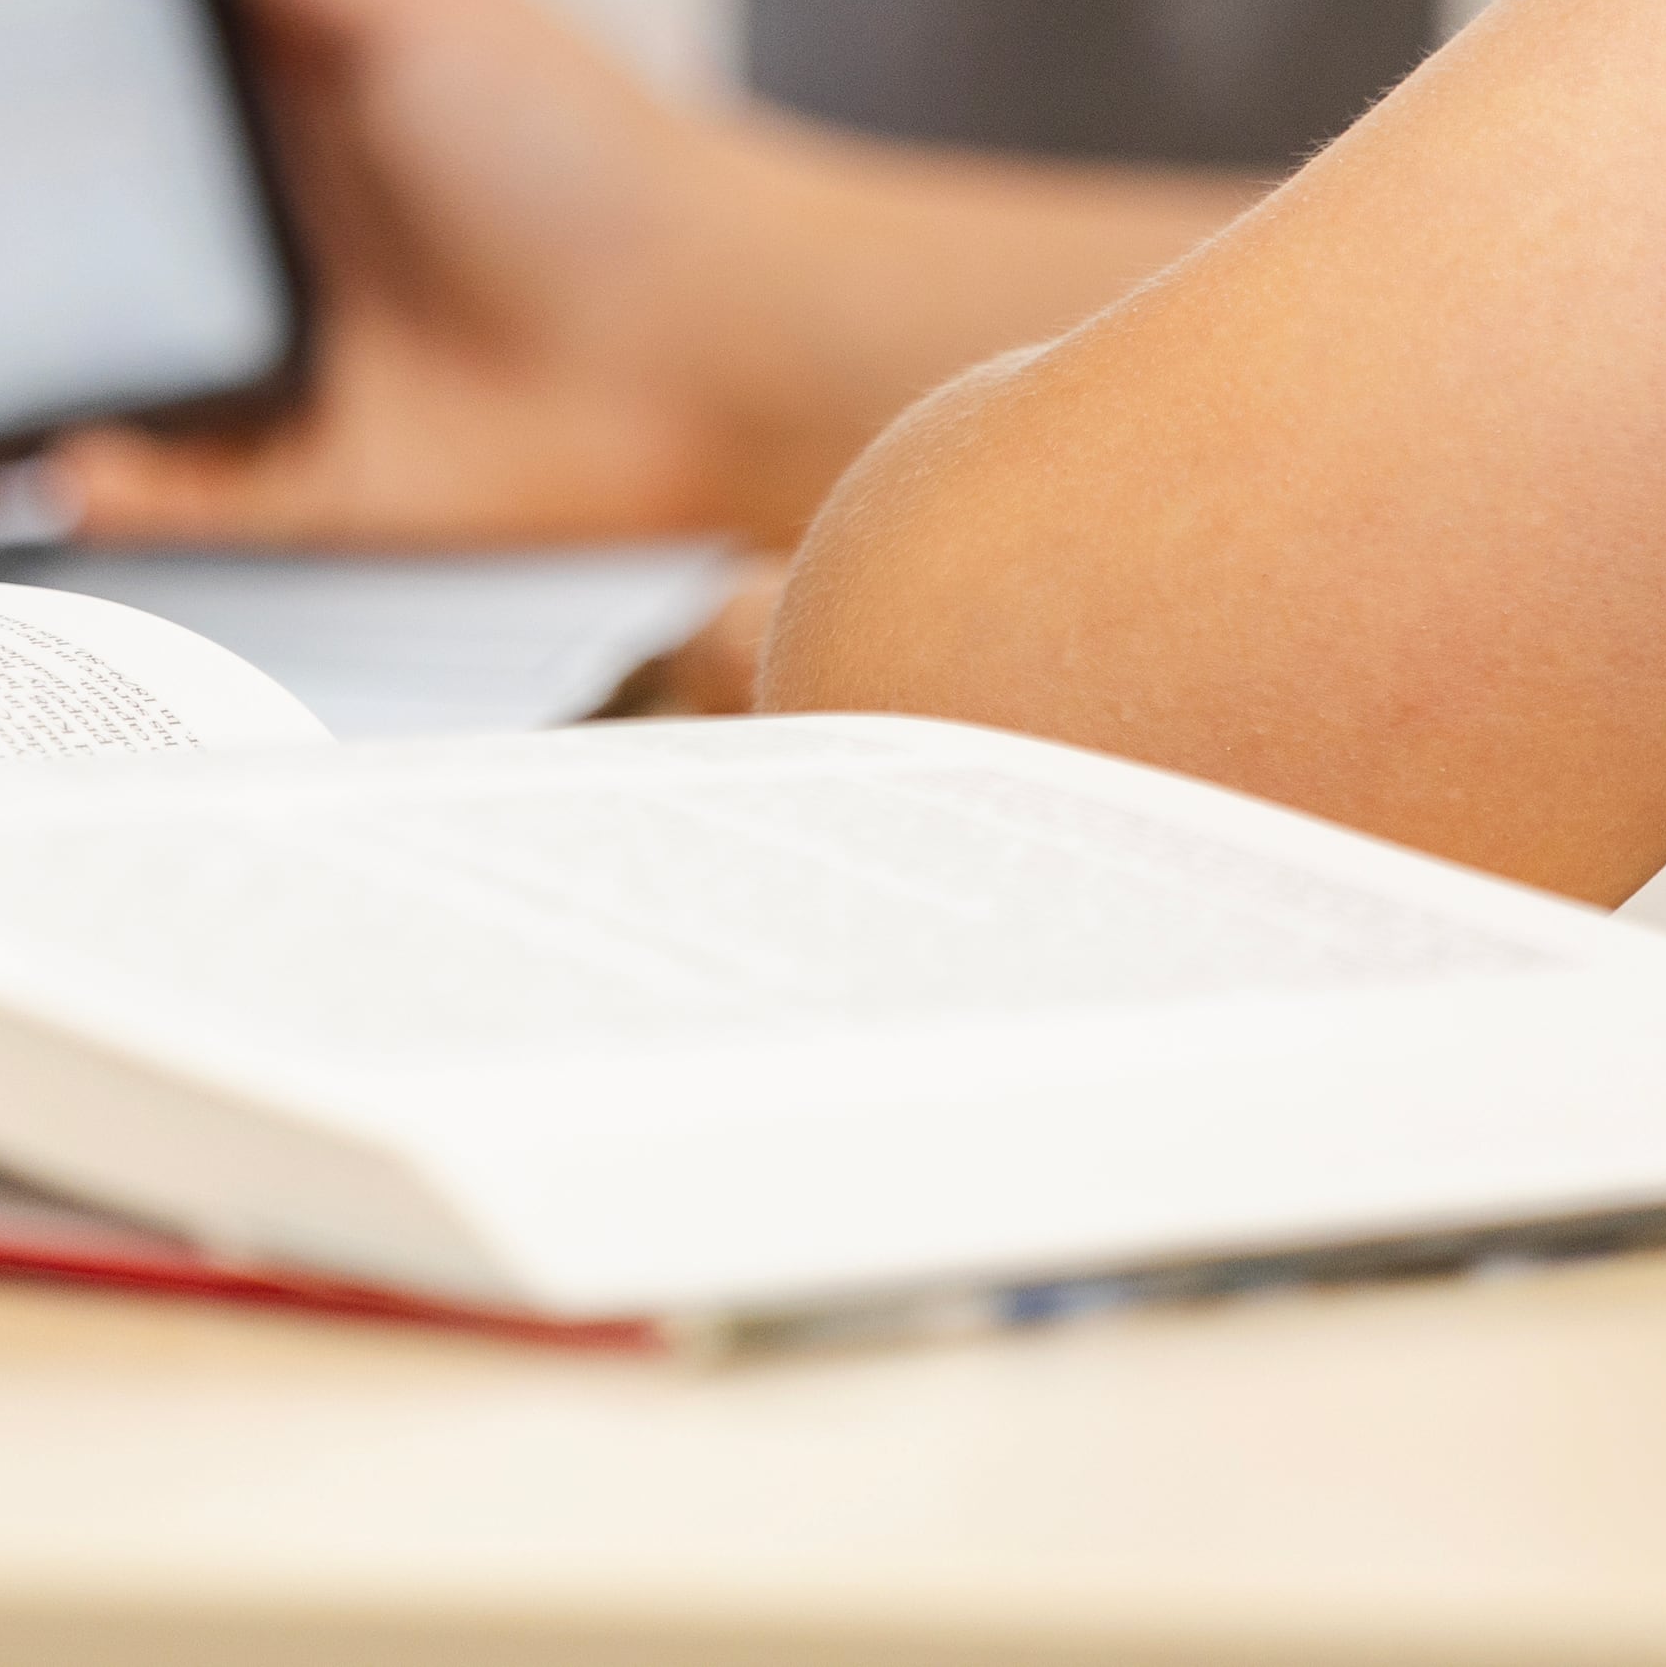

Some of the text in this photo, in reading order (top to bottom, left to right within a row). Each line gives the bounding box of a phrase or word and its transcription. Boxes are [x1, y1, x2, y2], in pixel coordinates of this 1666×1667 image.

[19, 675, 114, 745] properly
[71, 677, 153, 741] captain.
[74, 663, 152, 717] service
[74, 697, 140, 753] officer
[144, 719, 179, 747] his
